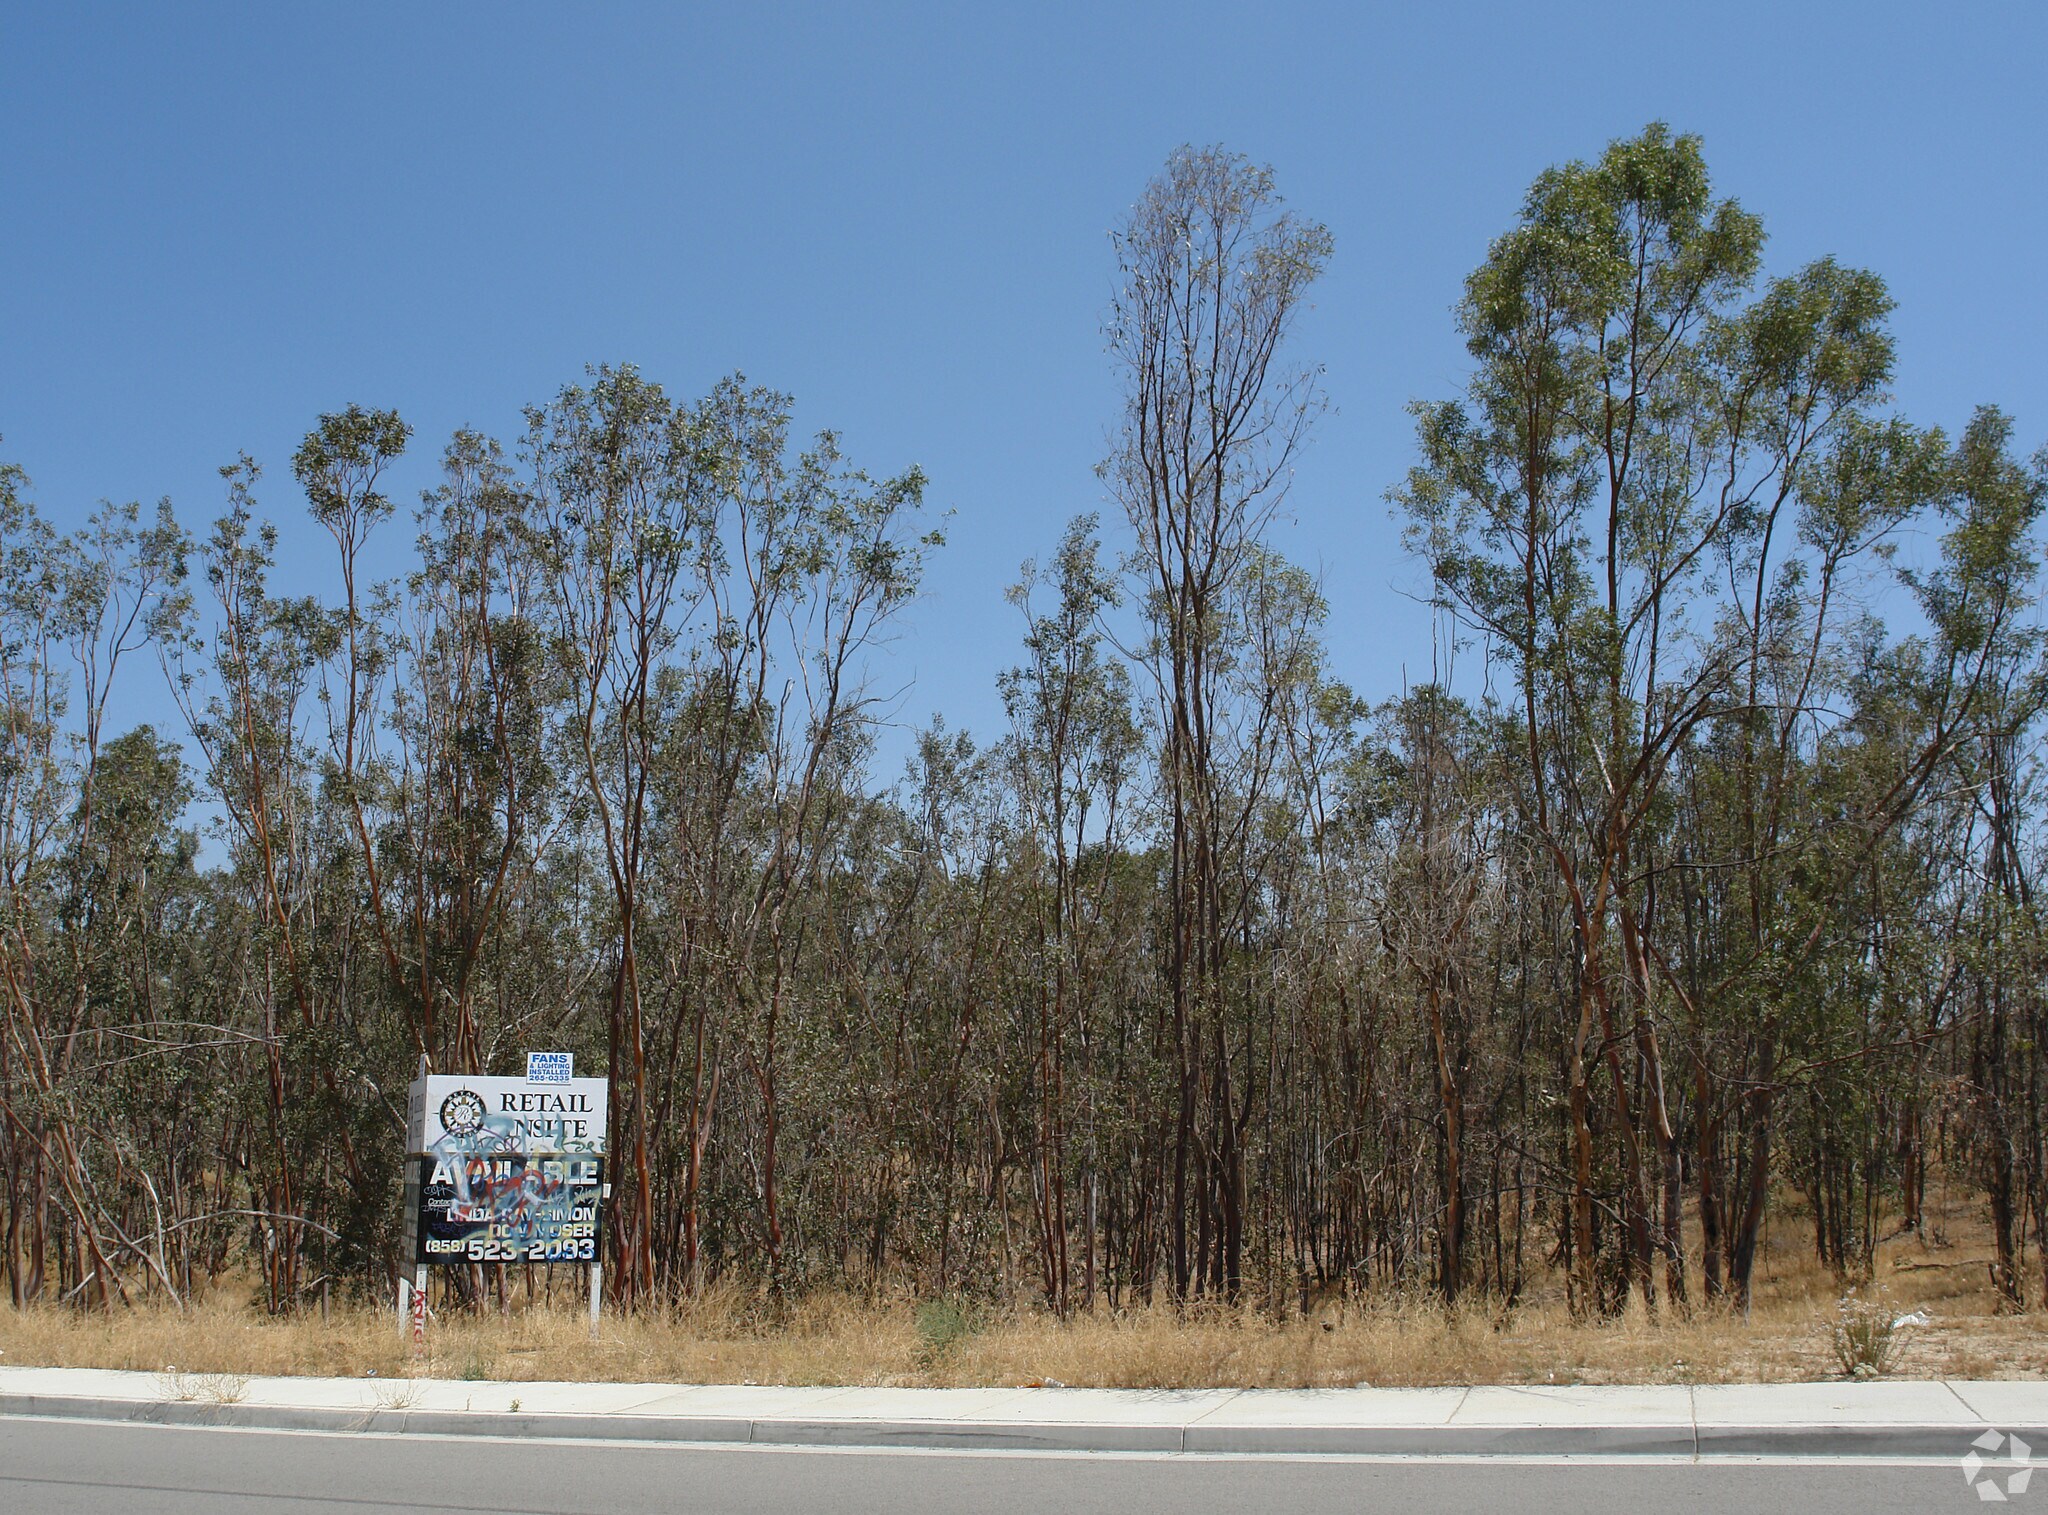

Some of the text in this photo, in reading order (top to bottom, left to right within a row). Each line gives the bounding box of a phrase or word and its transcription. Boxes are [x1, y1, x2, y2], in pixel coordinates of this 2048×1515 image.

[532, 1054, 567, 1063] FANS
[500, 1093, 593, 1112] RETAIL
[508, 1119, 588, 1137] NSITE
[429, 1160, 598, 1185] AAILABLE
[427, 1198, 455, 1207] Contac
[425, 1240, 466, 1253] (858)
[467, 1239, 595, 1260] 523-2093
